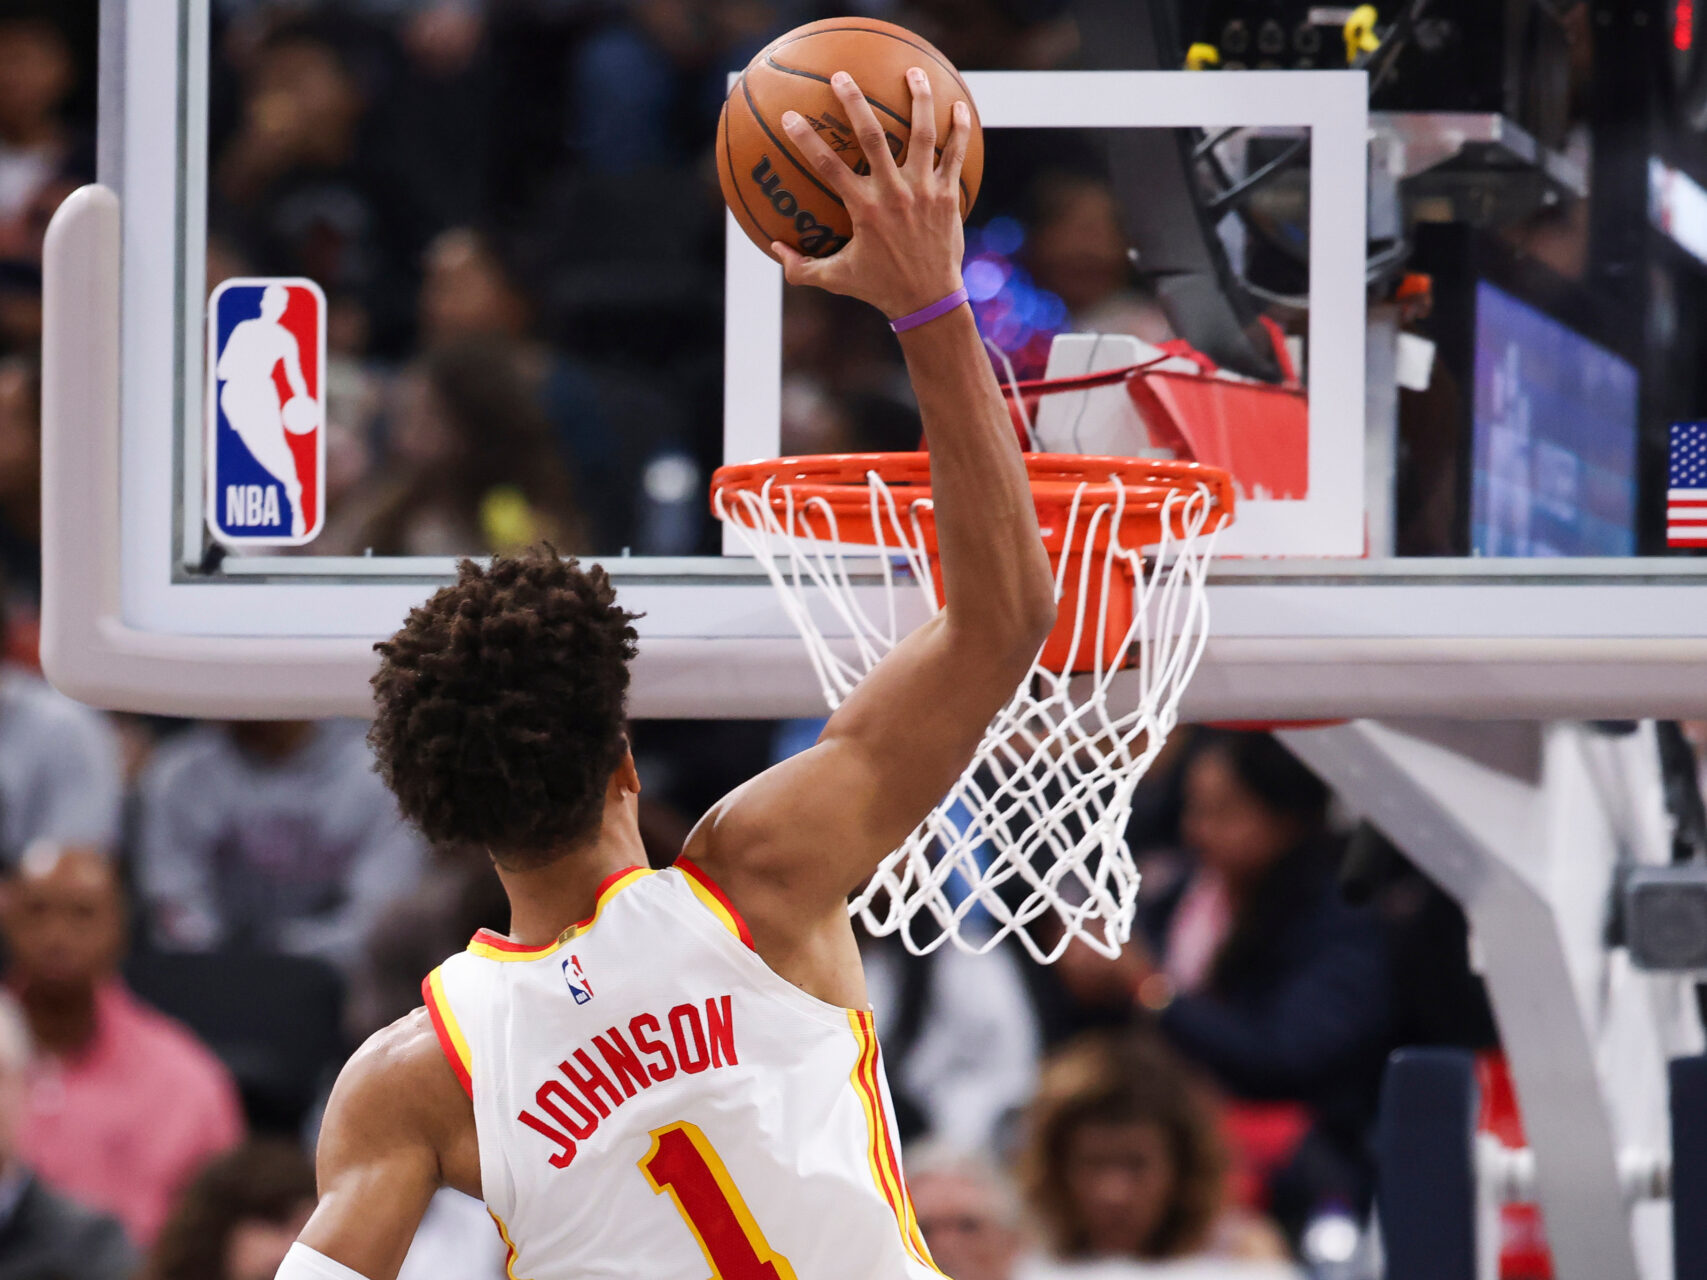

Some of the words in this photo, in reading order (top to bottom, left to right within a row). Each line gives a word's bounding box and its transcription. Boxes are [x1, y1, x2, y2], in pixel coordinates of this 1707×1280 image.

[752, 154, 852, 257] lson
[226, 484, 280, 526] NBA
[517, 995, 739, 1169] JOHNSON
